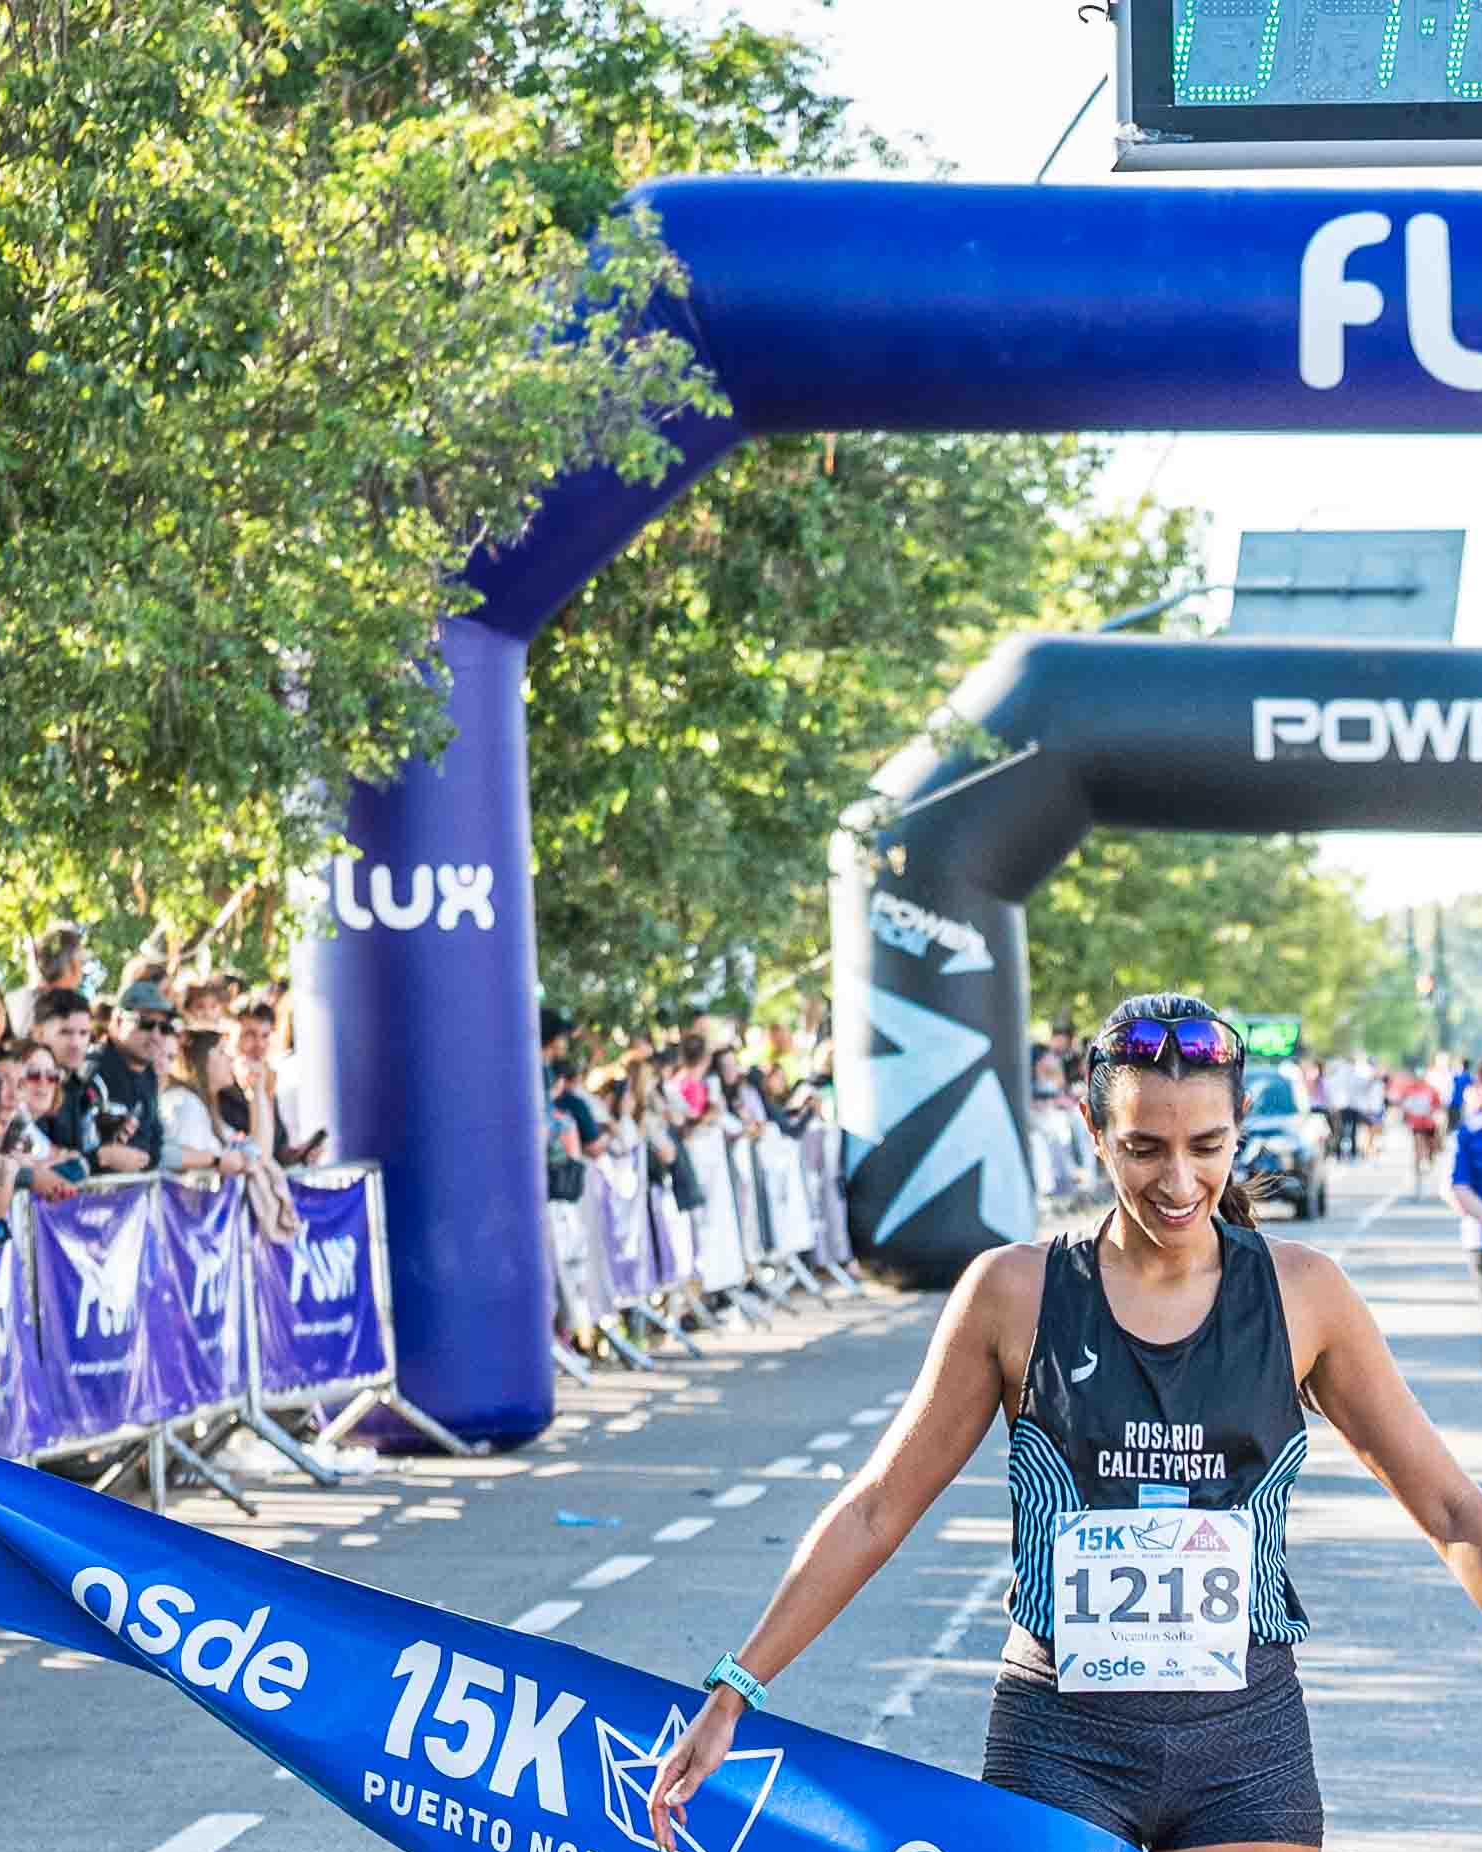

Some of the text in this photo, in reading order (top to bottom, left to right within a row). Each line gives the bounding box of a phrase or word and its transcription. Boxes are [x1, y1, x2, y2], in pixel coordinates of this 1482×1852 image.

[1124, 1421, 1205, 1452] ROSARIO
[1074, 1525, 1127, 1552] 15K
[1064, 1566, 1241, 1625] 1218
[70, 1565, 309, 1713] osde
[1083, 1655, 1147, 1682] osde
[383, 1639, 587, 1818] 15K
